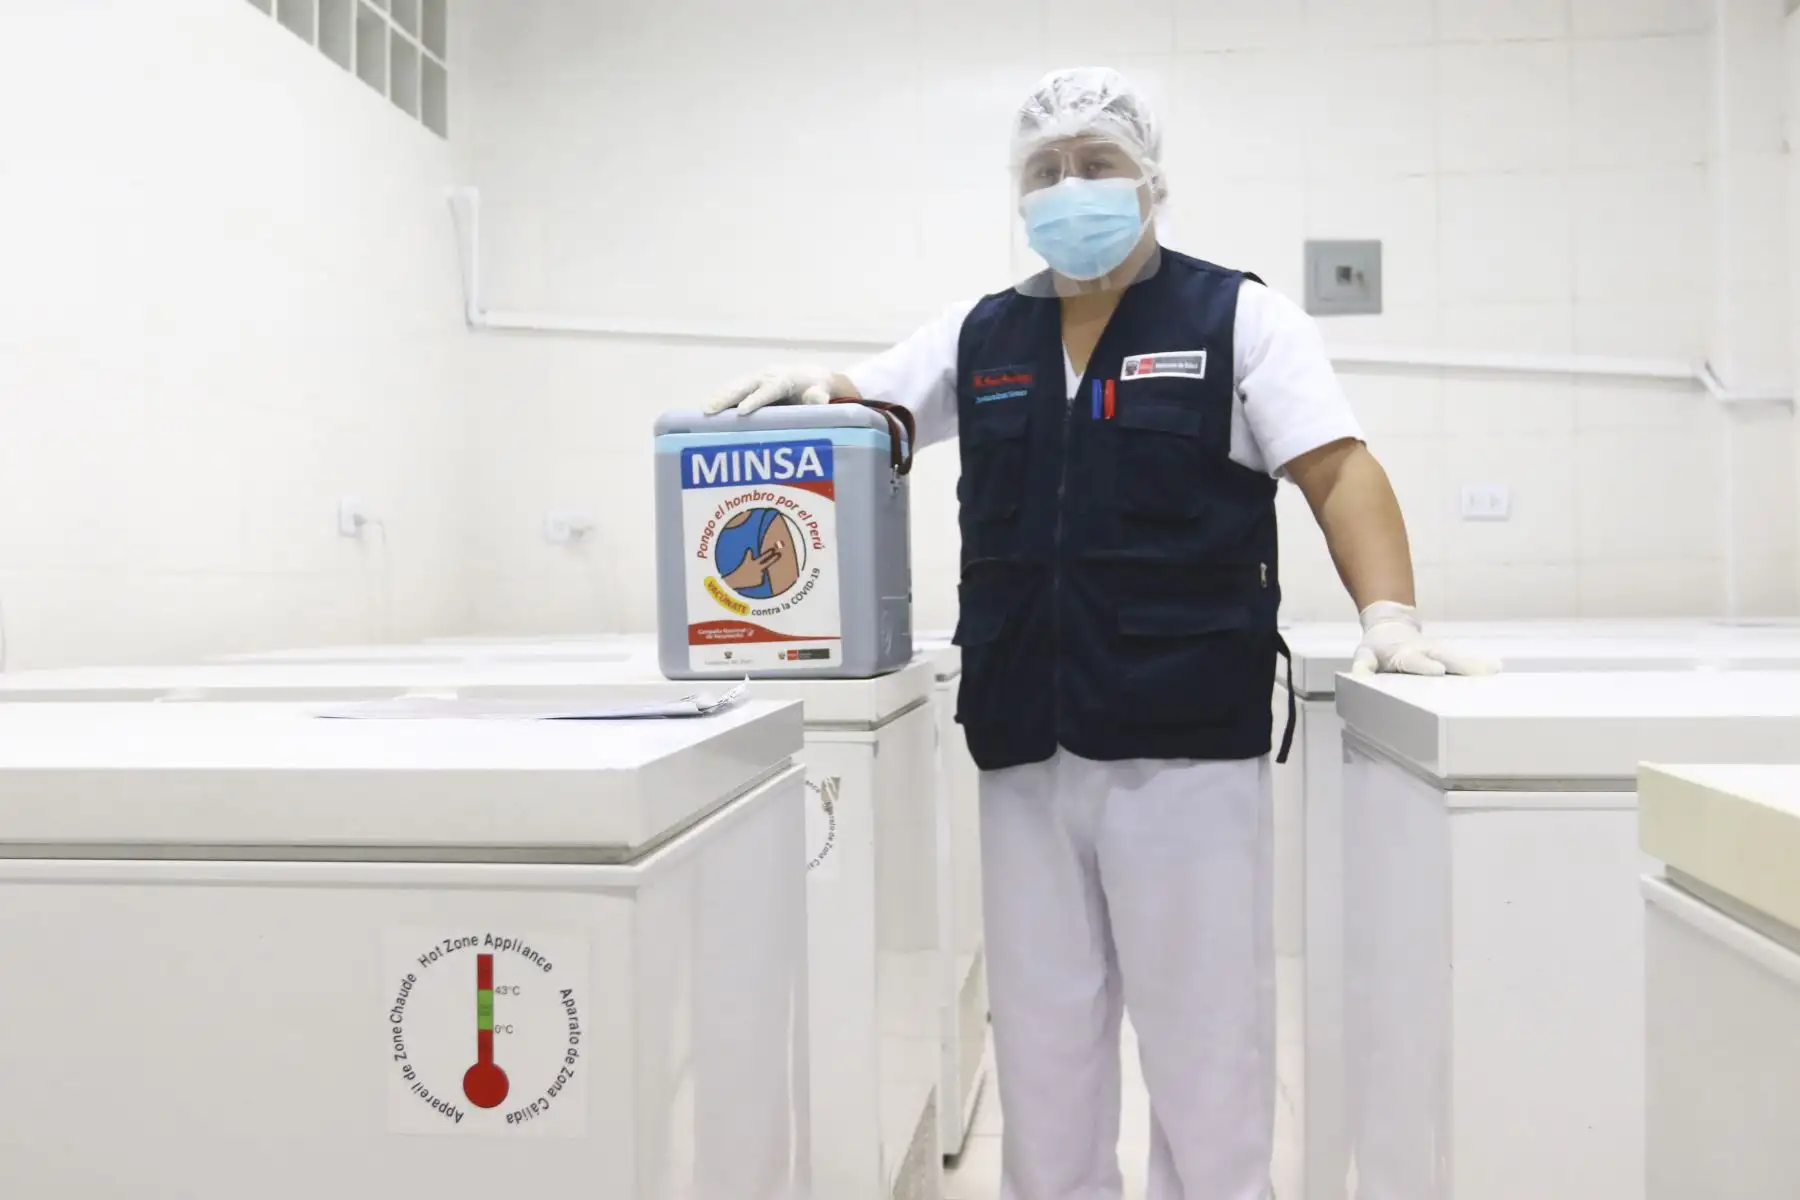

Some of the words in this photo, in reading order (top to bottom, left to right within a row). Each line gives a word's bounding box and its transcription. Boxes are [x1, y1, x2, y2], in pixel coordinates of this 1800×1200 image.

[691, 446, 824, 485] MINSA
[697, 519, 716, 559] Pongo
[714, 505, 725, 520] el
[724, 490, 775, 511] hombro
[775, 494, 800, 511] por
[797, 509, 812, 524] el
[805, 521, 826, 550] Perú
[751, 605, 781, 616] contra
[782, 602, 791, 611] la
[790, 567, 821, 606] COVID-19
[417, 946, 444, 968] Hot
[443, 934, 479, 953] Zone
[483, 932, 553, 973] Appliance
[389, 972, 417, 1024] Chaude
[495, 985, 521, 996] 43°C
[494, 1024, 514, 1034] 0°C
[560, 987, 581, 1045] Aparato
[392, 1026, 407, 1062] Zone
[565, 1048, 580, 1065] de
[402, 1064, 416, 1081] de
[547, 1066, 574, 1099] Zona
[410, 1080, 464, 1124] Appareil
[506, 1097, 550, 1124] Cálida
